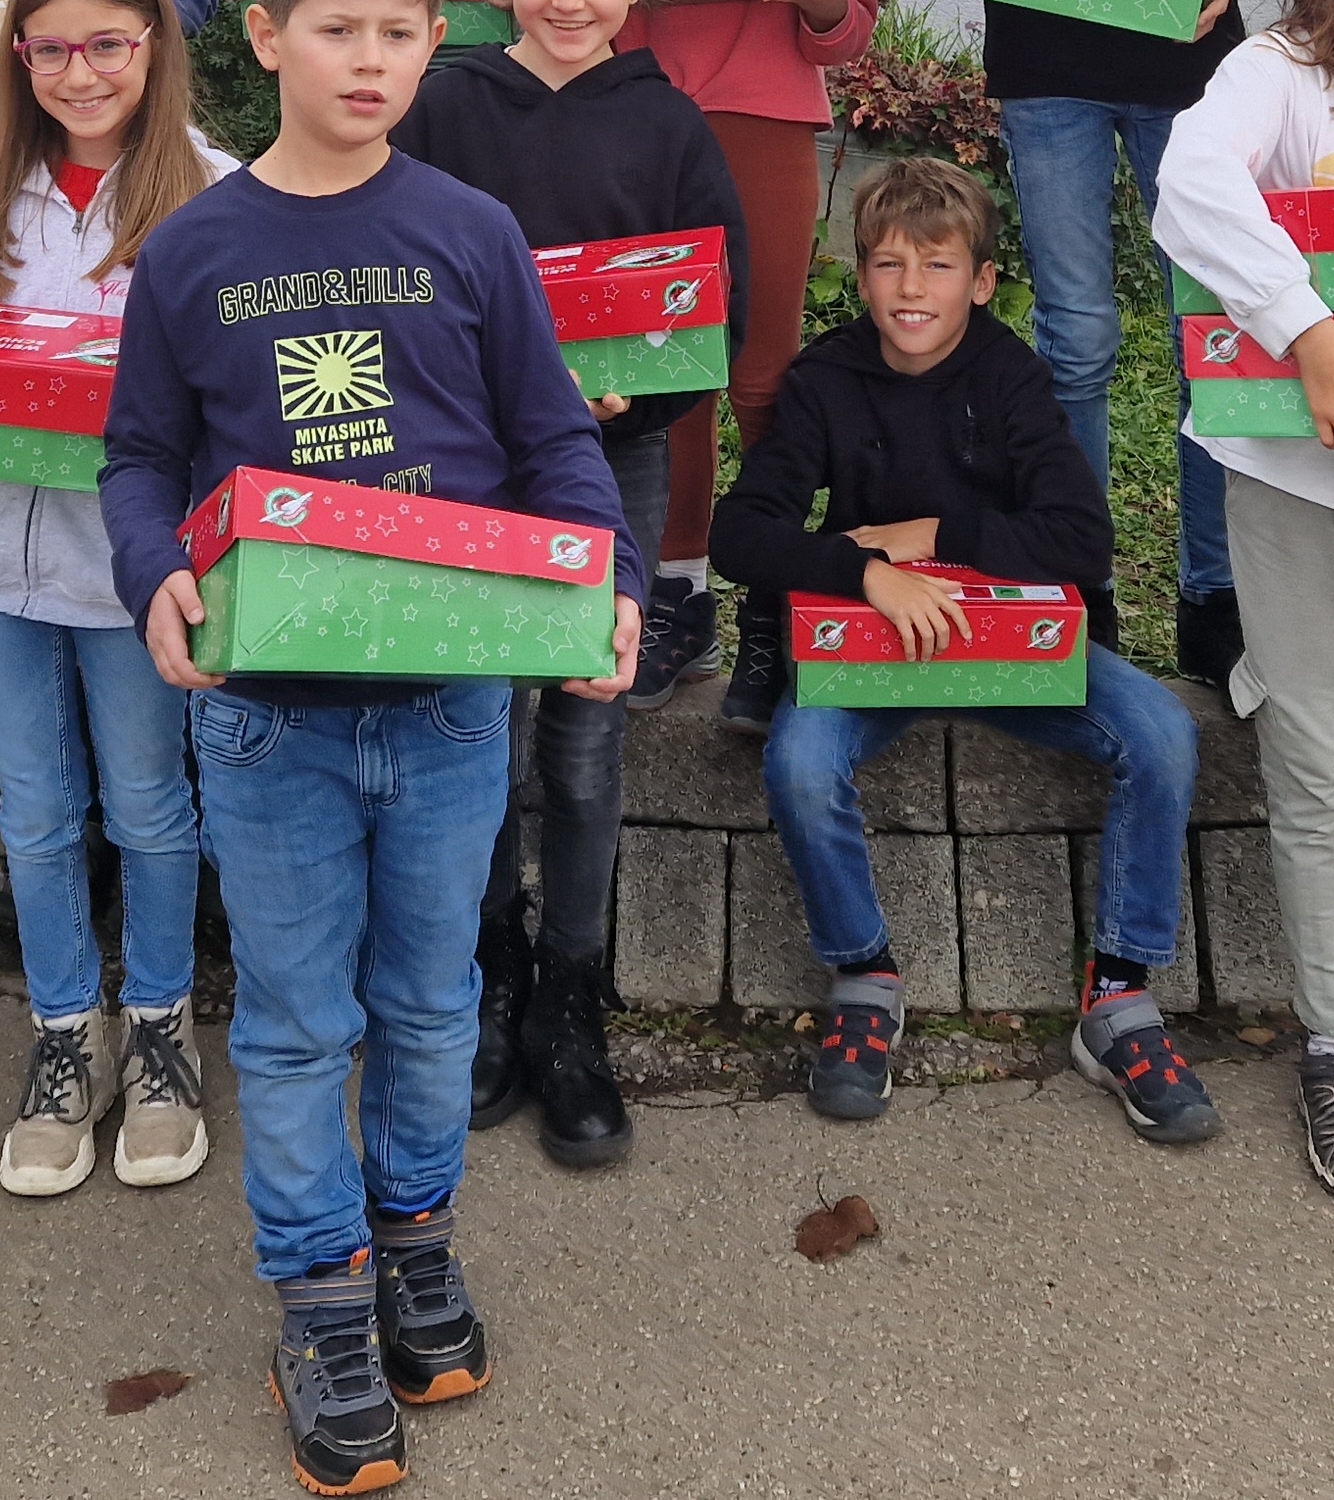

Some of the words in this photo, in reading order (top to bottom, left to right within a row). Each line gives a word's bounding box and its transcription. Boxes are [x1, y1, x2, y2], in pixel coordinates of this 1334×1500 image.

[217, 267, 434, 325] GRAND&HILLS
[295, 418, 388, 446] MIYASHITA
[291, 444, 345, 466] SKATE
[351, 435, 395, 458] PARK
